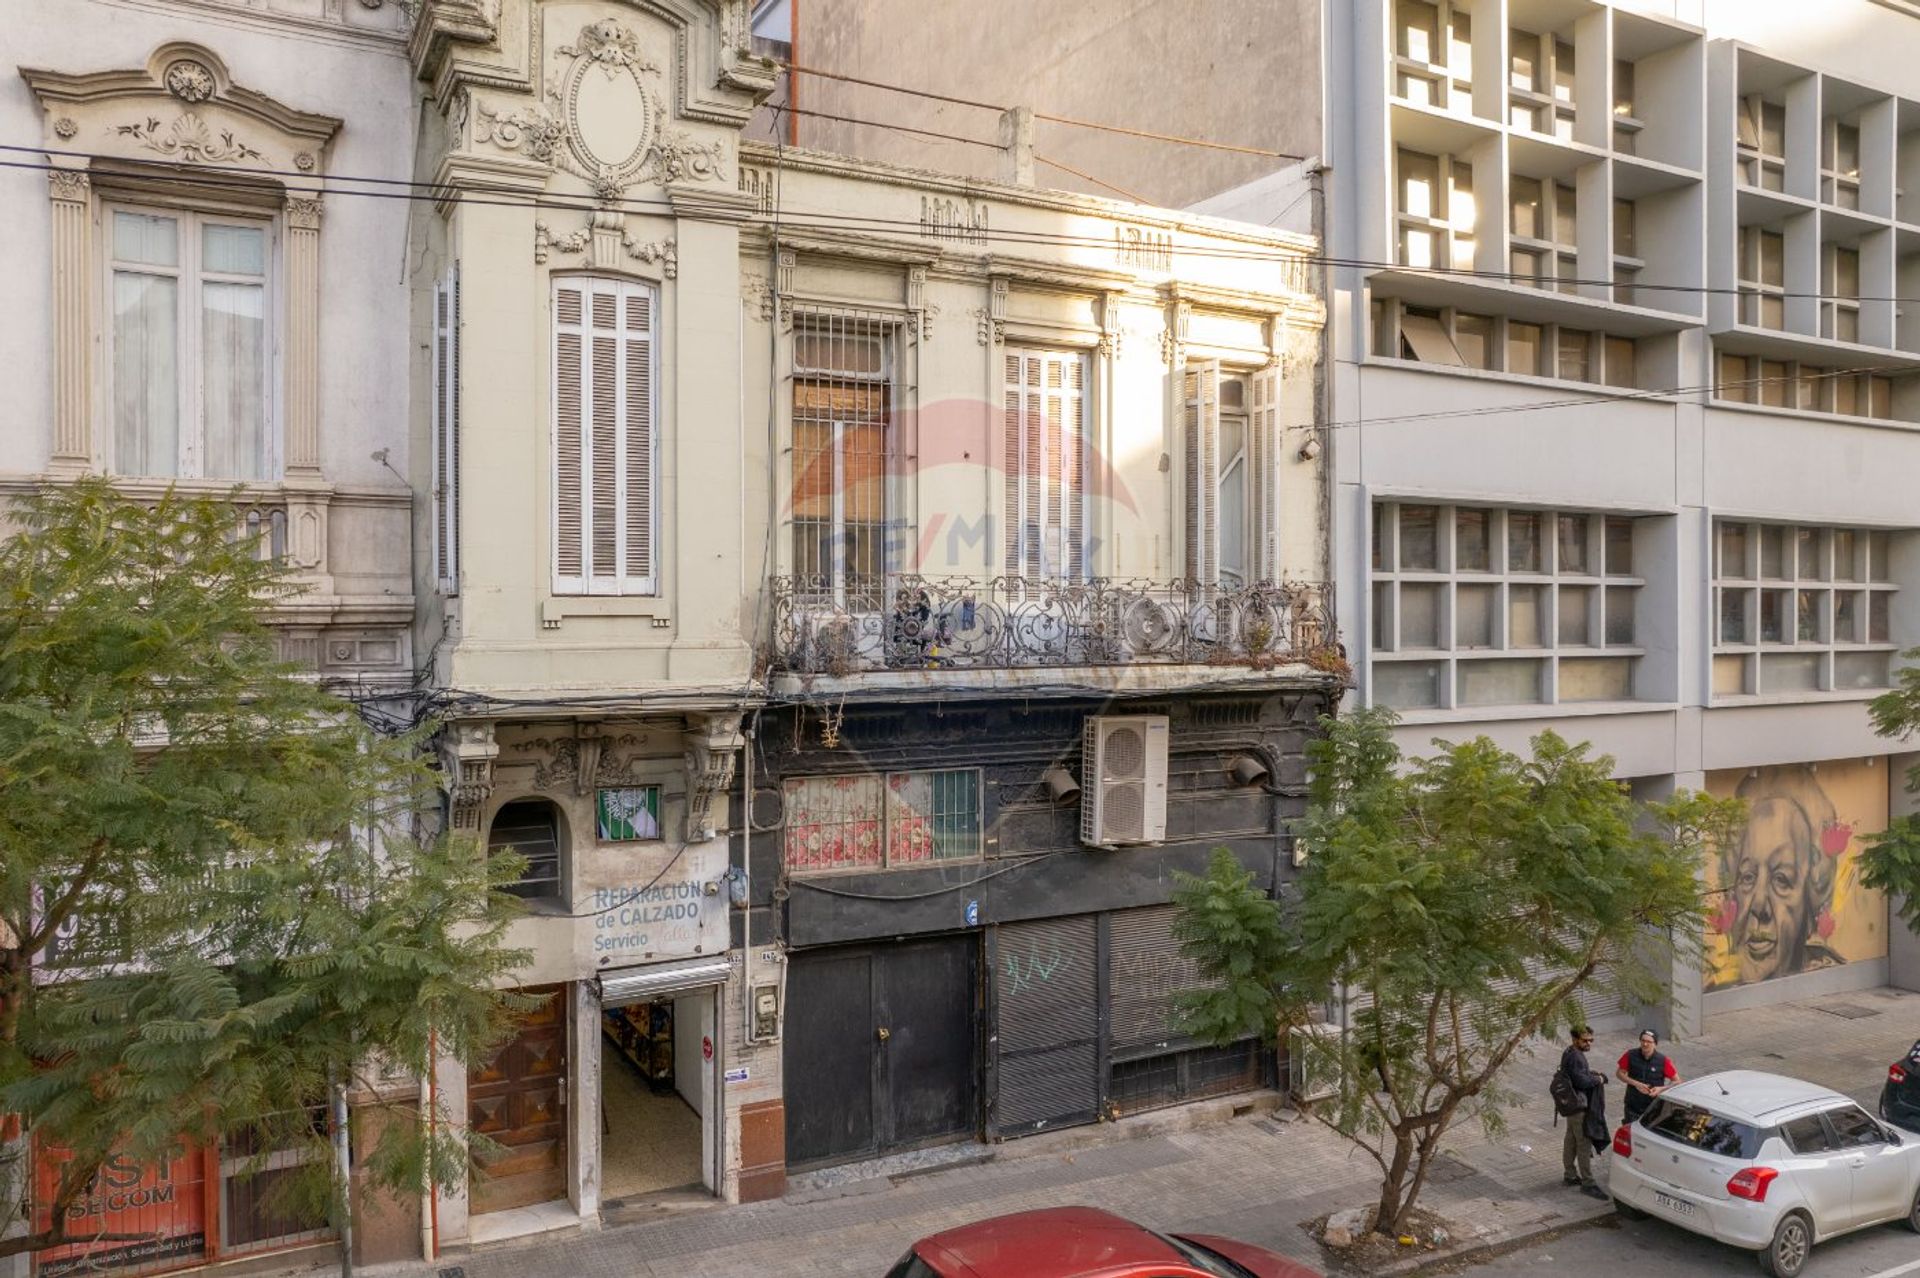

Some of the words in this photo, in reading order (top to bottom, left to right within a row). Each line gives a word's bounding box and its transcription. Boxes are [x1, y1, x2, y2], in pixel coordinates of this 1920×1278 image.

[596, 913, 615, 929] de
[620, 903, 698, 926] CALZADO
[595, 933, 648, 951] Servicio
[67, 1184, 174, 1219] SECOM
